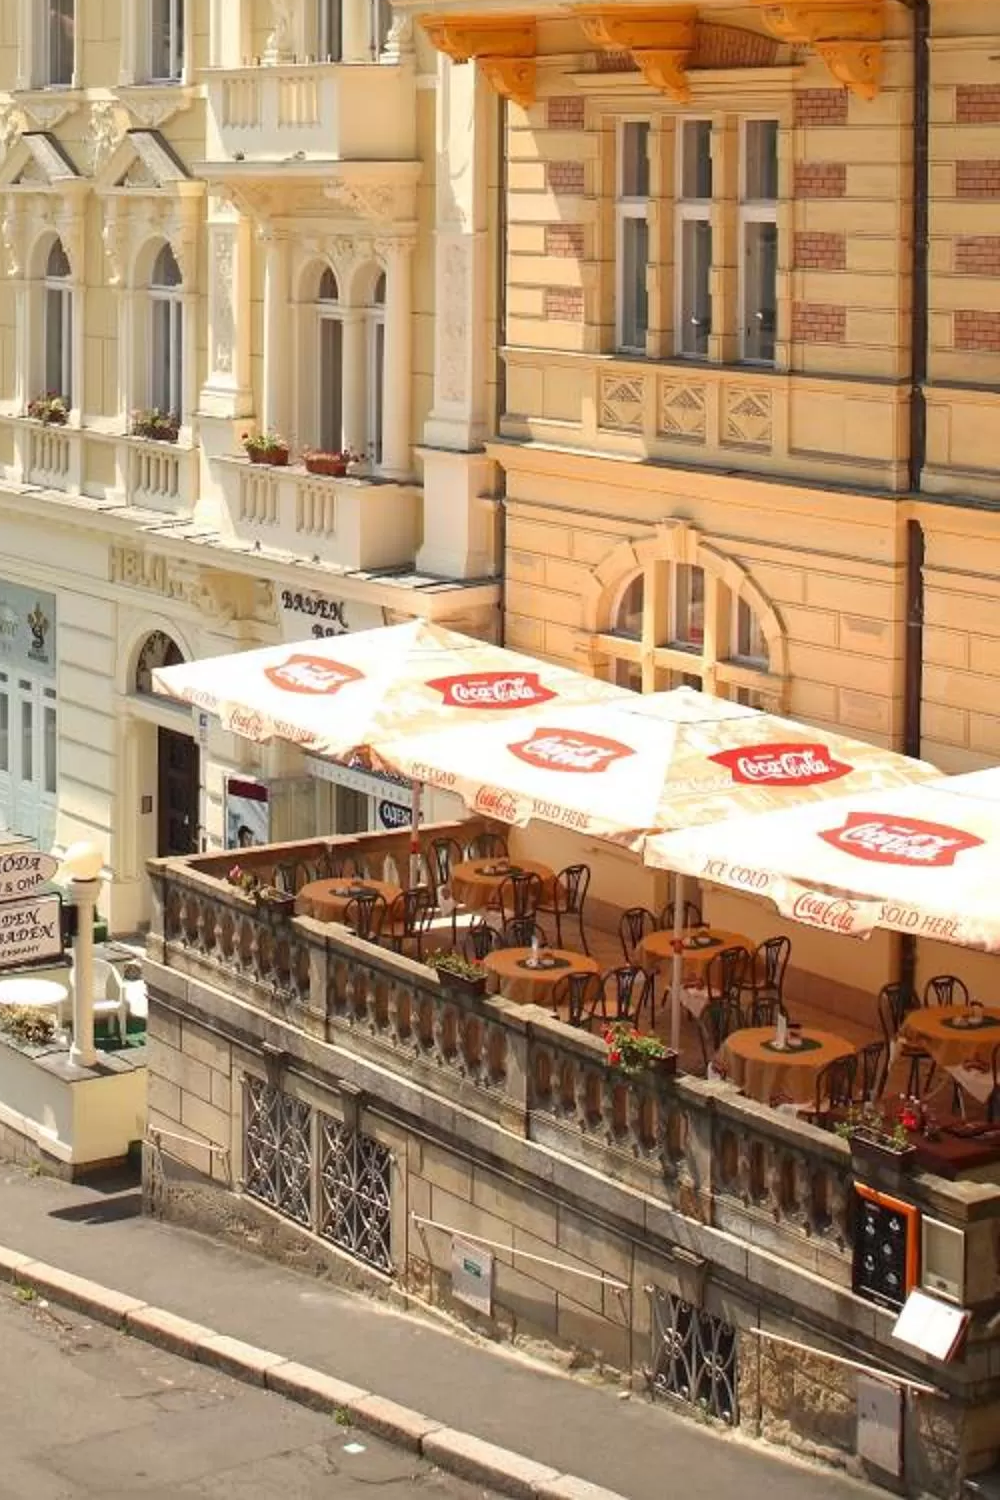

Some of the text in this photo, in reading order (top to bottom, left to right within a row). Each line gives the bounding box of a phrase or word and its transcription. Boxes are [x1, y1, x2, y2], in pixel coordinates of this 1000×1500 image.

[282, 590, 349, 628] BADEN
[451, 676, 539, 703] Coca-Cola
[737, 749, 830, 781] Coca-Cola
[701, 859, 769, 889] ICE COLD
[793, 892, 962, 938] Coca-Cola SOLD HERE
